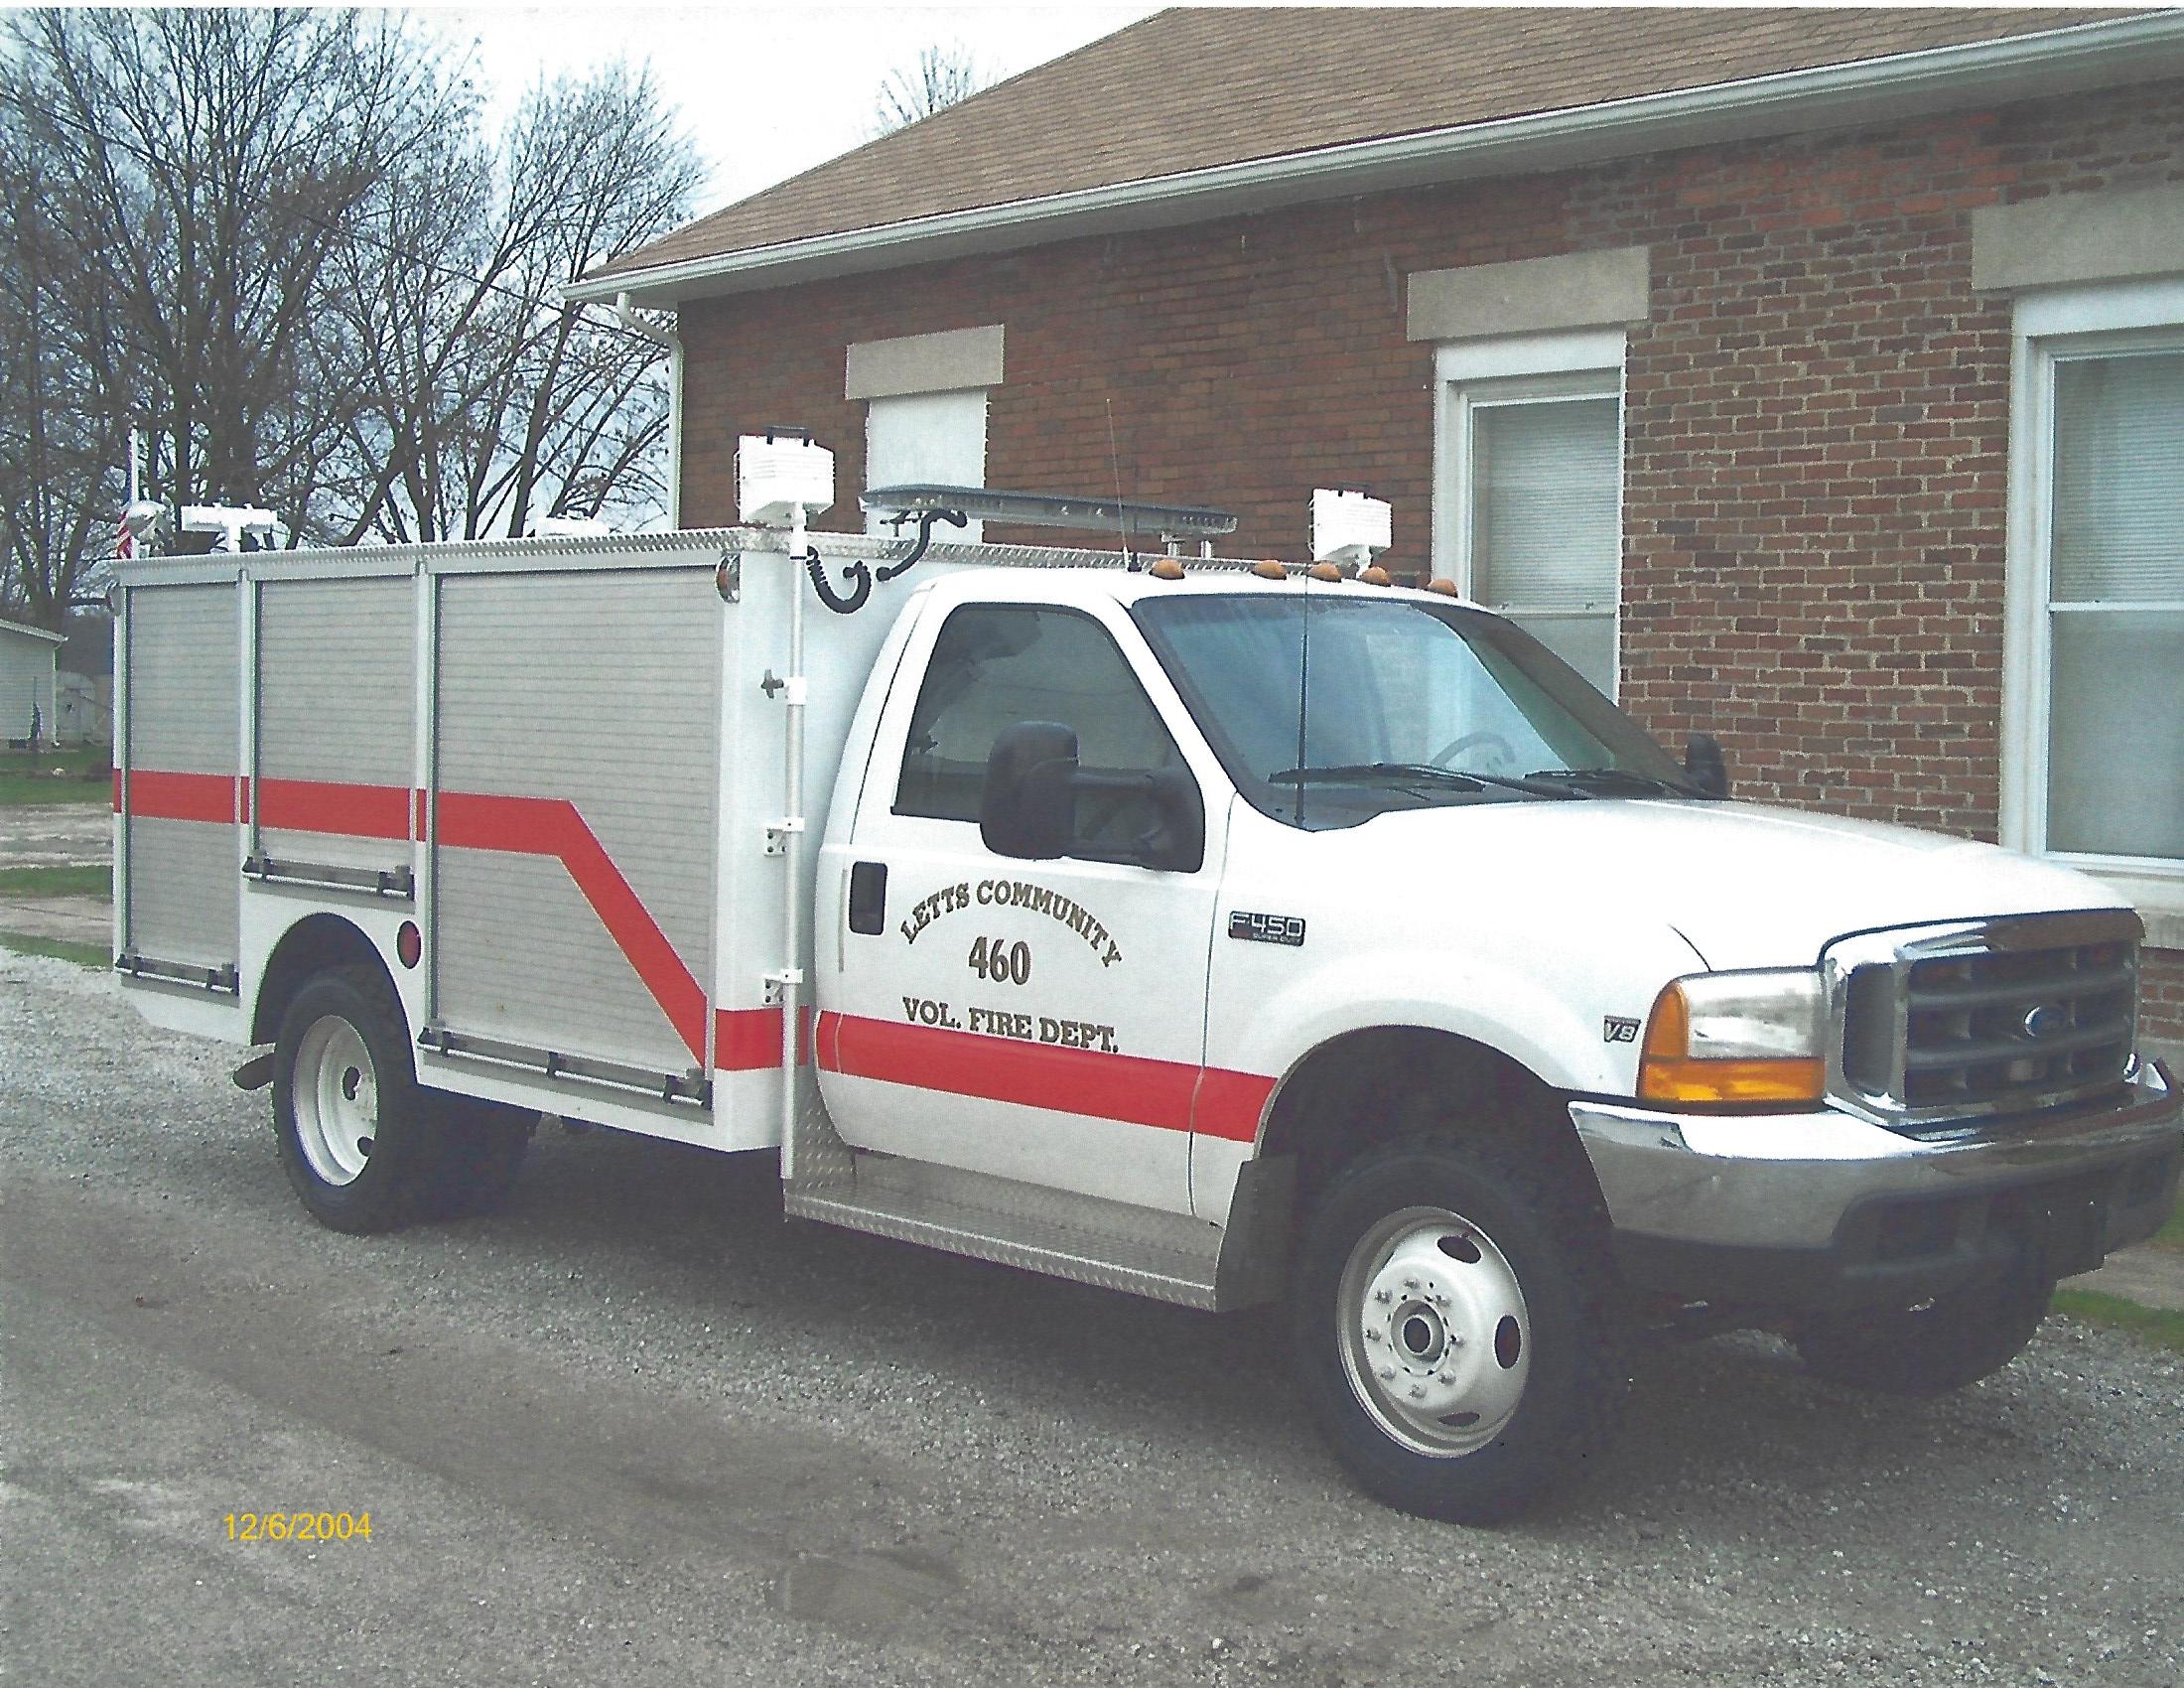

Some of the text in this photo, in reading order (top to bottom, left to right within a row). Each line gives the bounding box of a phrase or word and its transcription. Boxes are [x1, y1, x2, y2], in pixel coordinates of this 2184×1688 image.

[900, 880, 1123, 968] LETTS COMMUNITY
[1230, 913, 1303, 937] F450
[969, 936, 1031, 985] 460
[902, 996, 1119, 1053] VOL. FIRE DEPT.
[1605, 1022, 1636, 1042] V8
